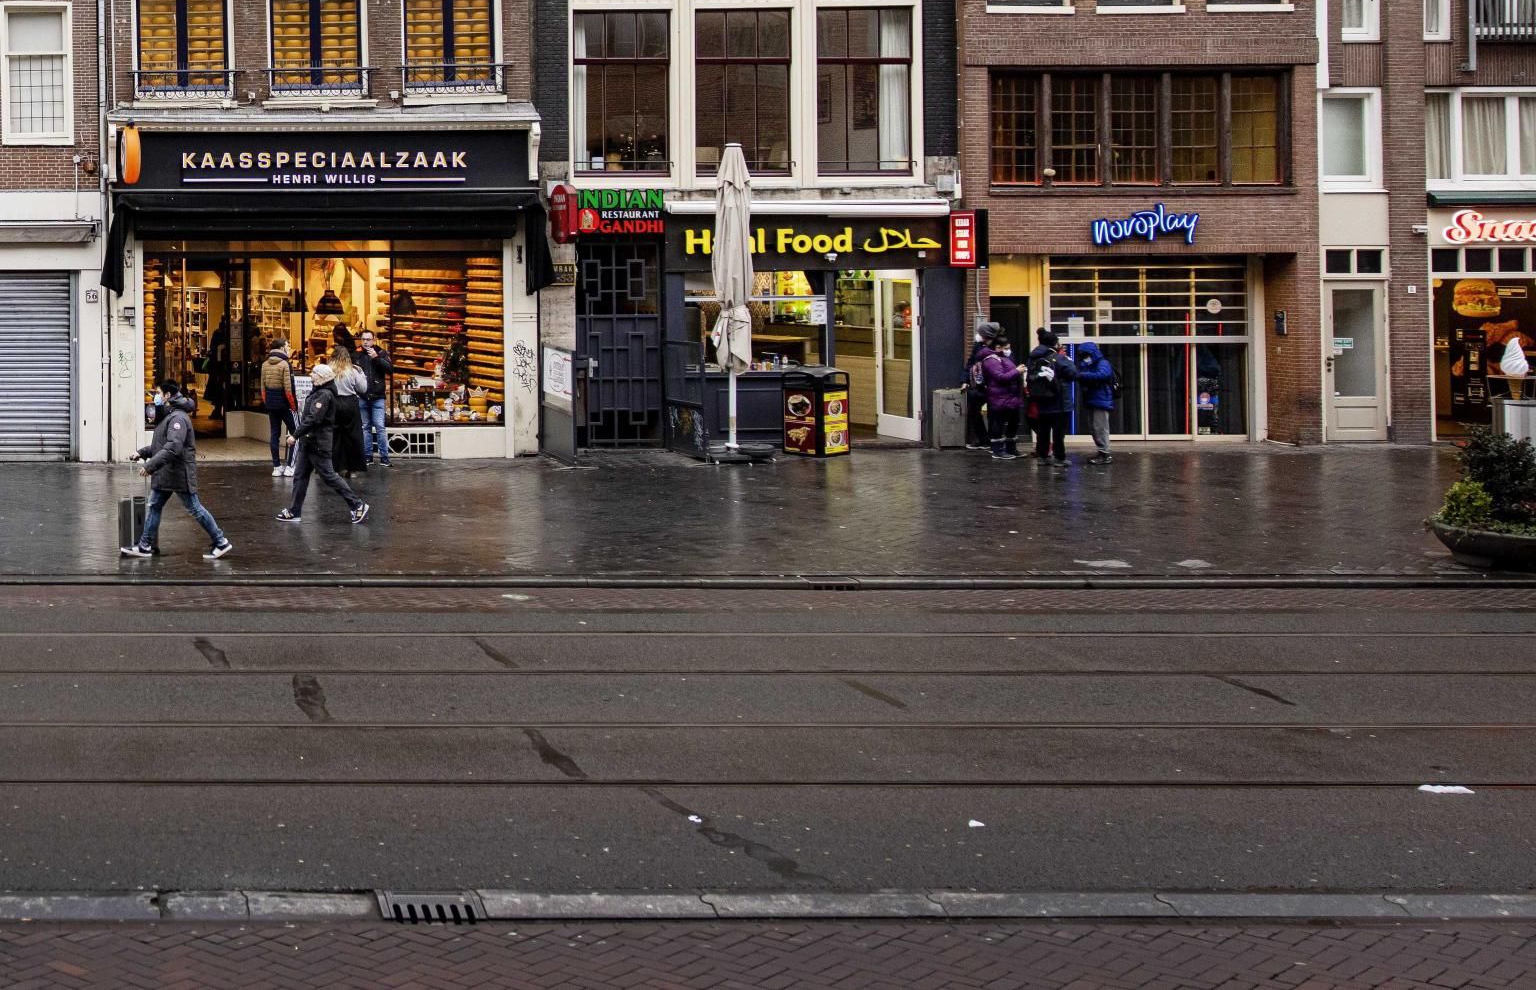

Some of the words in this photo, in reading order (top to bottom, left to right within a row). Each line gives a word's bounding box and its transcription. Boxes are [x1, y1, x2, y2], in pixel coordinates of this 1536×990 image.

[182, 151, 468, 169] KAASSPECIAALZAAK
[272, 174, 317, 184] HENRI
[325, 174, 377, 184] WILLIG
[577, 189, 664, 209] INDIAN
[601, 210, 660, 219] RESTAURANT
[600, 220, 664, 233] GANDHI
[776, 227, 853, 253] Food
[863, 227, 942, 253] حلال
